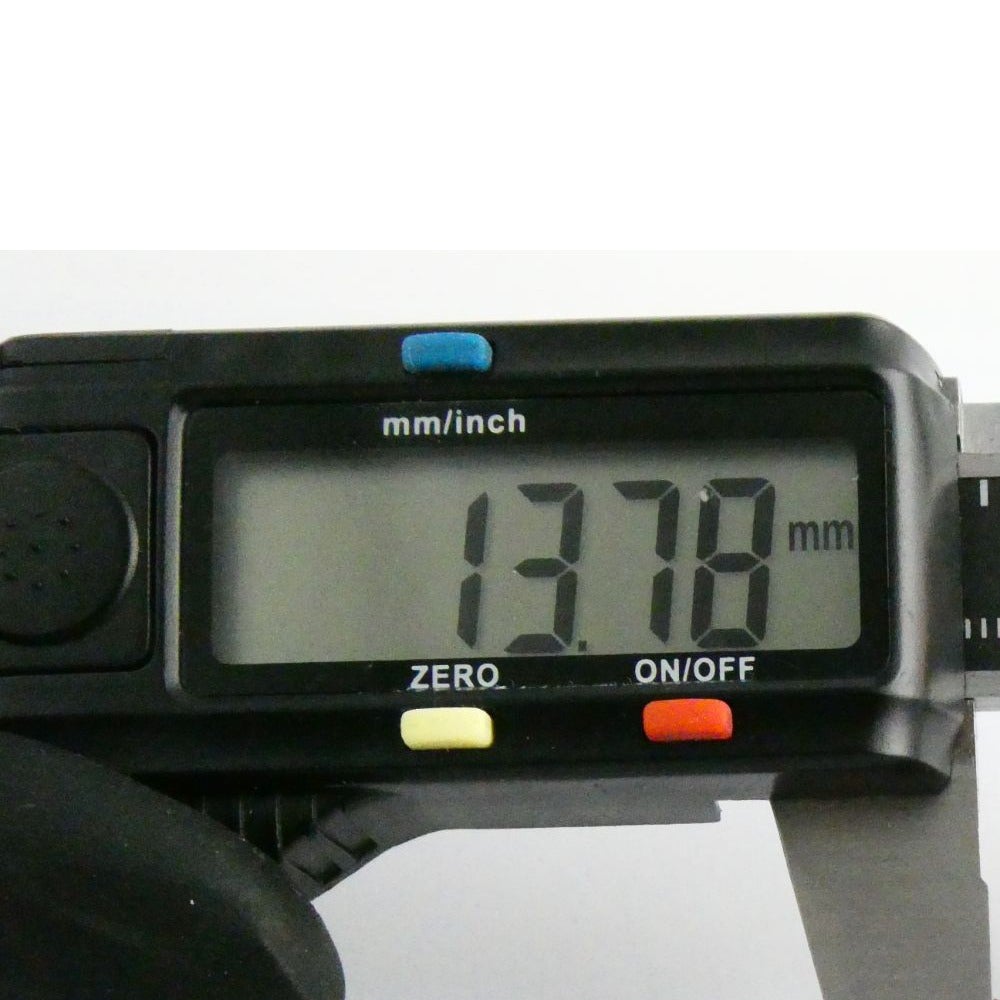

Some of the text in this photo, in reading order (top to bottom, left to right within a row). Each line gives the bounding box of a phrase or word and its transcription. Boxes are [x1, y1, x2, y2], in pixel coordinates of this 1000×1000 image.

[382, 408, 527, 437] mm/inch
[457, 478, 855, 654] 13.78 mm
[410, 663, 500, 689] ZERO
[634, 656, 756, 684] ON/OFF
